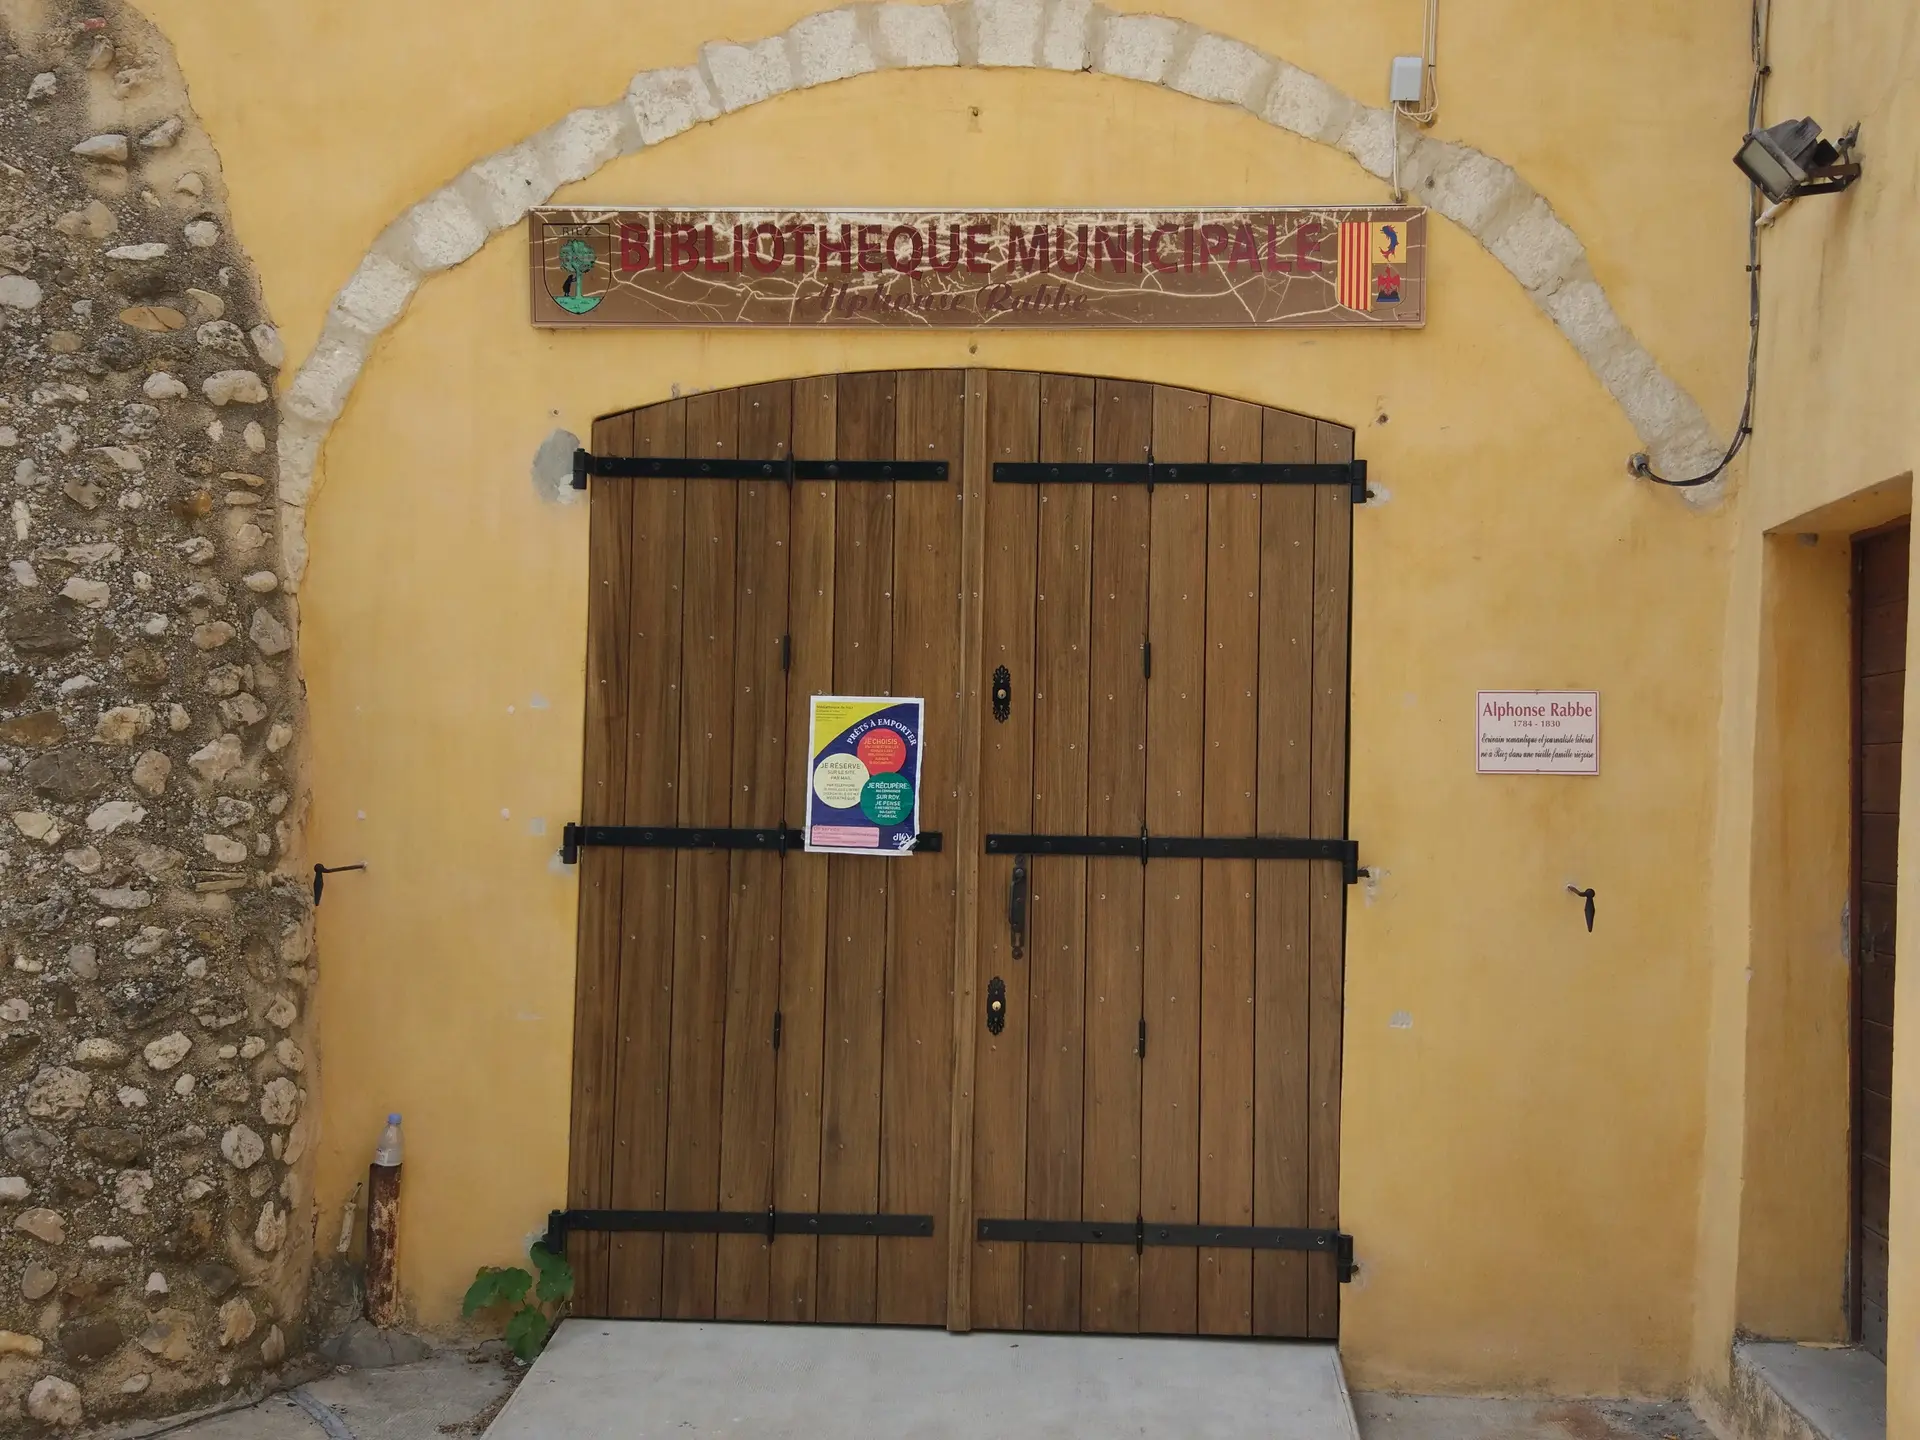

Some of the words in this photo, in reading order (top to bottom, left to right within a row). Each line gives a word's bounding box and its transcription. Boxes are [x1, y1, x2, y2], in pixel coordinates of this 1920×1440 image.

[562, 226, 592, 236] RIEZ
[620, 222, 992, 280] BIBLIOTHEQUE
[1007, 222, 1323, 274] MUNICIPALE
[974, 282, 1088, 313] Rabbe
[1482, 701, 1546, 721] Alphonse
[1550, 701, 1593, 717] Rabbe
[1513, 720, 1533, 728] 1784
[1541, 720, 1561, 728] 1830
[847, 722, 869, 744] PRÊTS
[870, 719, 876, 727] À
[878, 718, 917, 746] EMPORTER
[1505, 734, 1537, 748] romantique
[1538, 734, 1545, 743] et
[1542, 734, 1574, 747] journaliste
[1575, 734, 1594, 743] libéral
[1509, 748, 1522, 758] dans
[1551, 748, 1572, 762] famille
[830, 762, 861, 770] RÉSERVE
